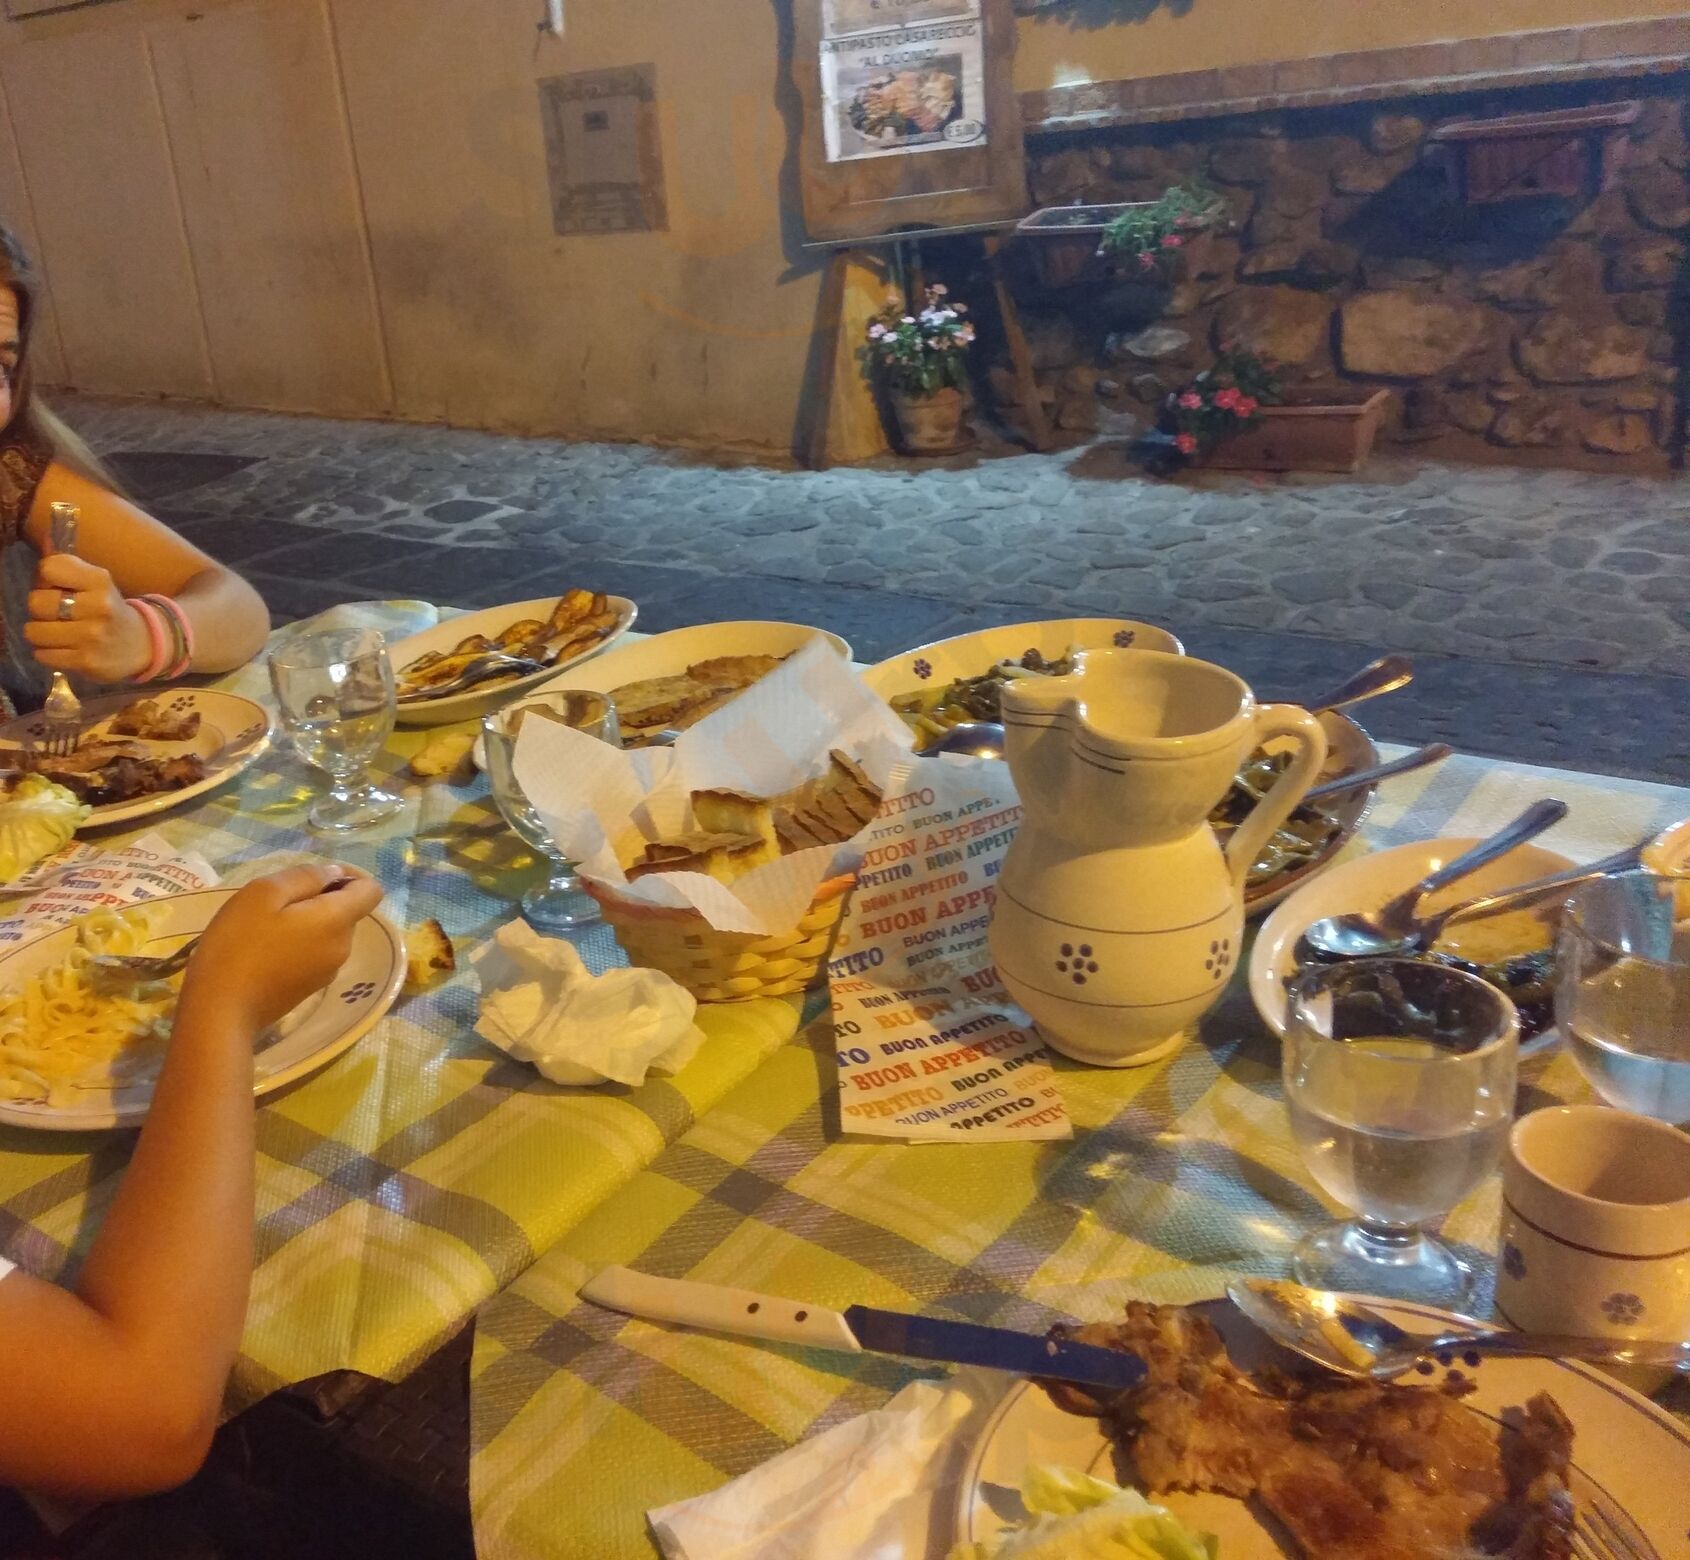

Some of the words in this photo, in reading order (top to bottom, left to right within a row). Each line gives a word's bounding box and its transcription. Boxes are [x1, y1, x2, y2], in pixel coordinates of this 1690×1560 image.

[869, 824, 904, 841] TITO
[913, 811, 952, 829] BUON
[958, 797, 1001, 817] APPE
[876, 788, 935, 819] TITO
[926, 848, 963, 871] BUON
[860, 890, 897, 914] BUON
[901, 870, 969, 901] APPETITO
[860, 907, 928, 940] BUON
[903, 928, 946, 948] BUON
[951, 915, 989, 938] APPE
[906, 947, 944, 967] BUON
[873, 999, 954, 1031] BUON
[879, 1037, 928, 1056] BUON
[929, 1014, 1009, 1046] APPETITO
[850, 1062, 917, 1091] BUON
[919, 1030, 1027, 1076] APPETITO
[951, 1067, 1004, 1093] BUON
[941, 1088, 1008, 1117] APPETITO
